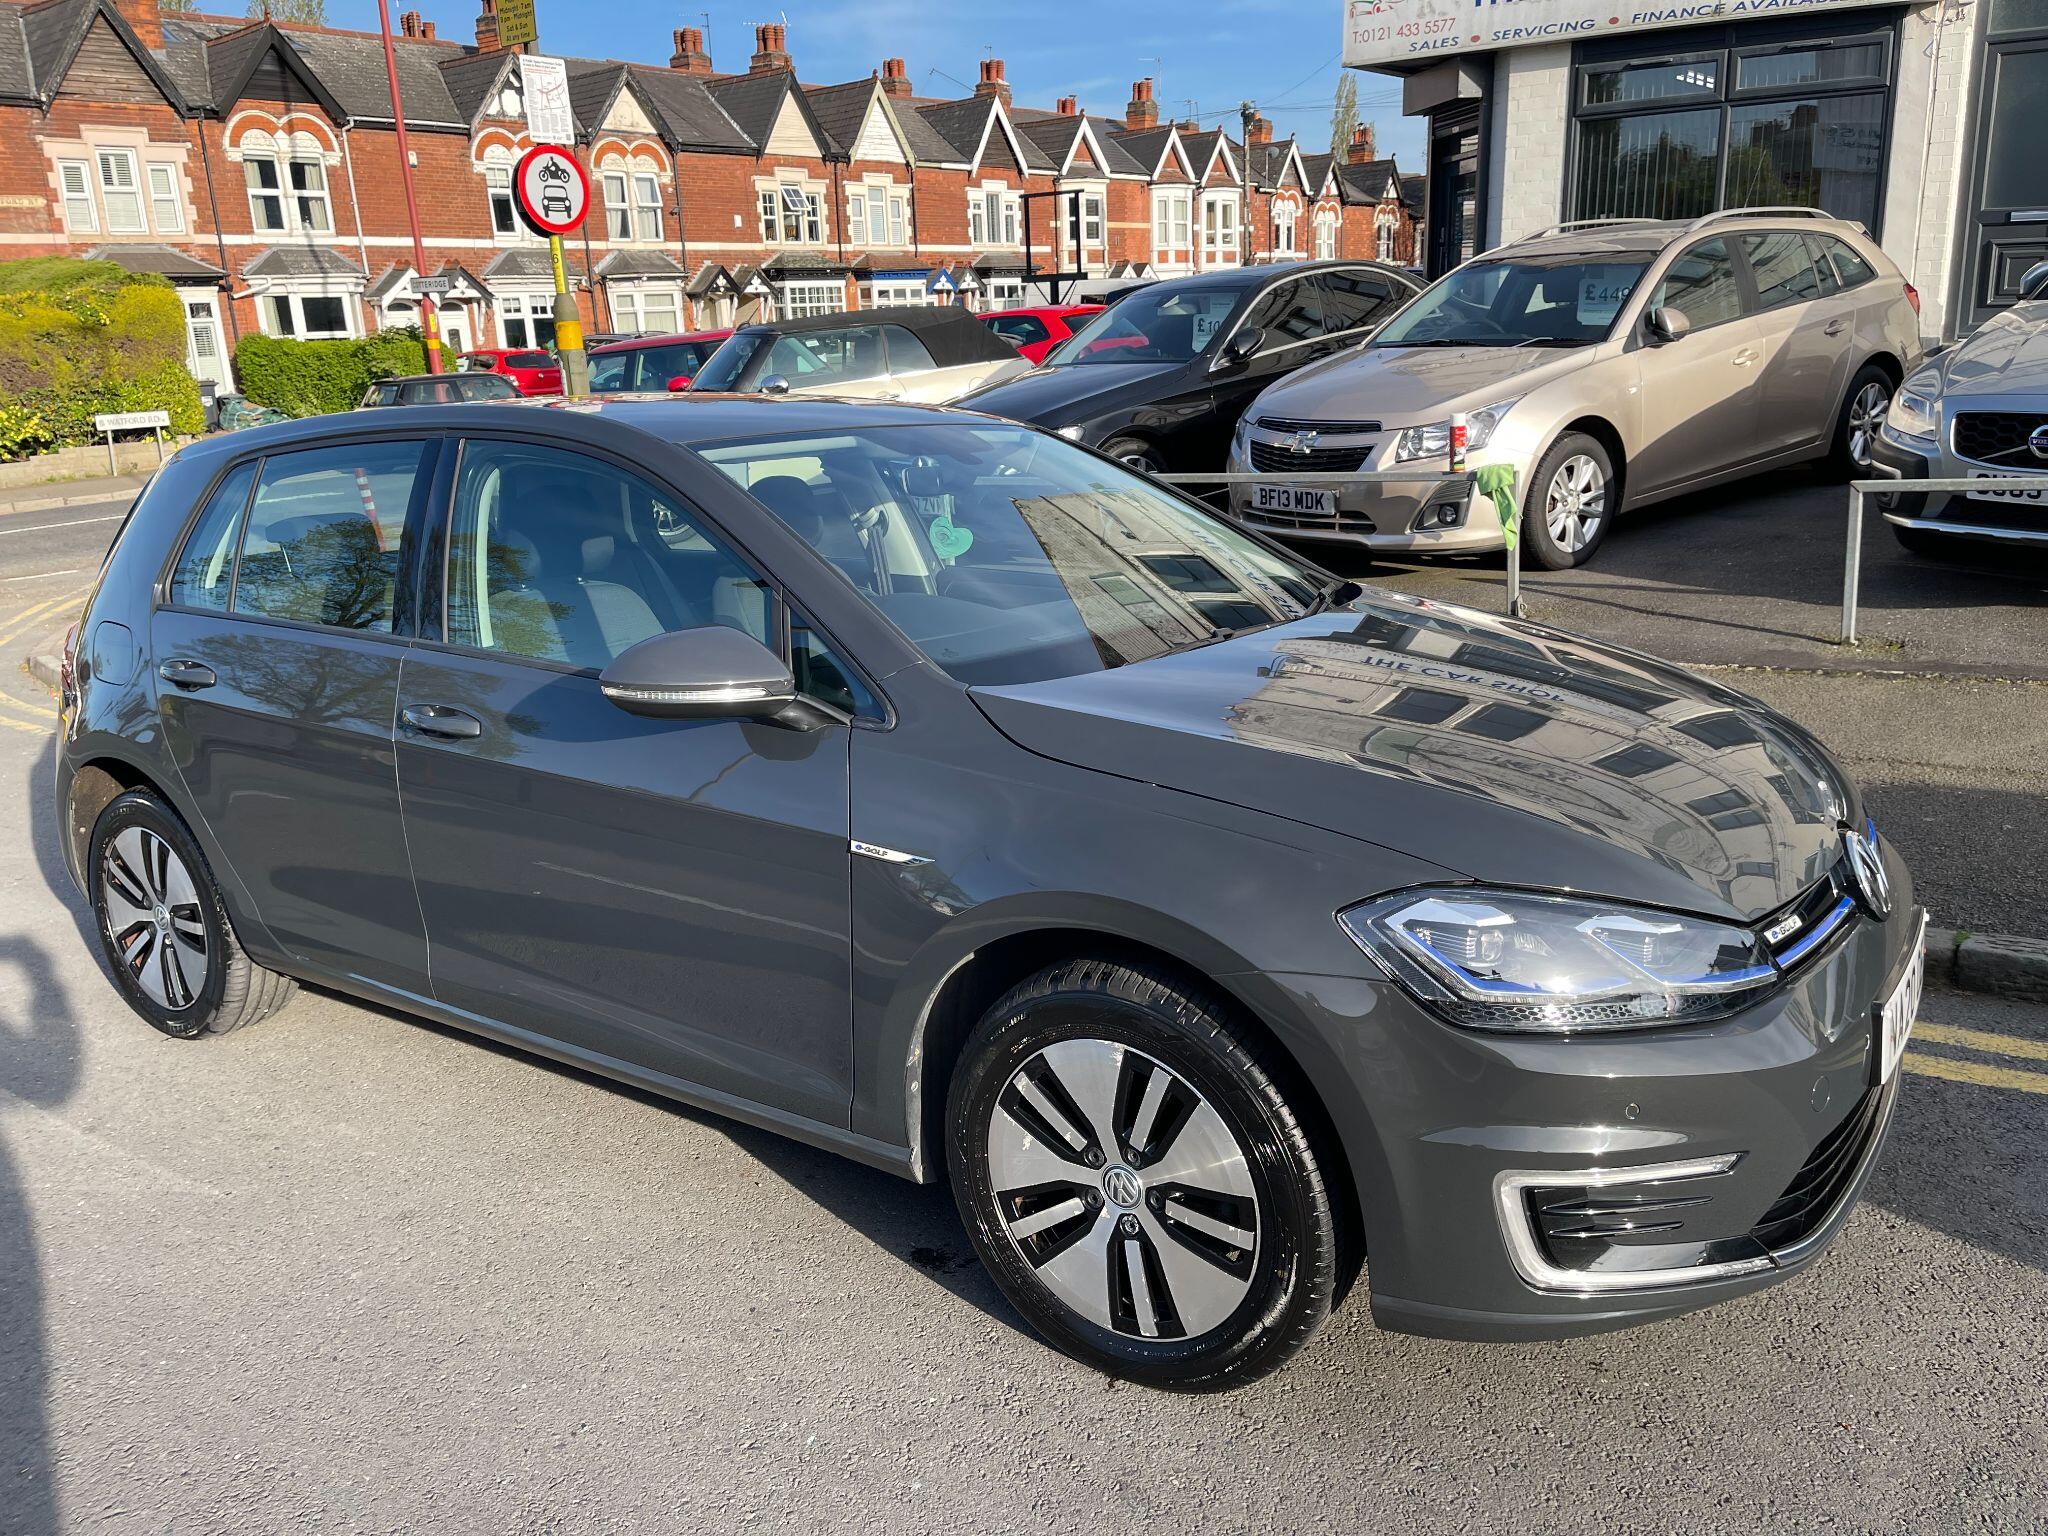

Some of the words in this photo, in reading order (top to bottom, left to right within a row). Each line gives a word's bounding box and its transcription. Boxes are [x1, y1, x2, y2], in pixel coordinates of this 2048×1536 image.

[1353, 27, 1391, 44] T:0121
[1397, 22, 1420, 38] 433
[1424, 17, 1456, 35] 5577
[1409, 36, 1459, 52] SALES
[1492, 19, 1596, 41] SERVICING
[1631, 3, 1726, 24] FINANCE
[1732, 0, 1846, 13] AVAIL
[411, 279, 448, 290] COTTERIDGE
[106, 416, 146, 426] WATFORD
[148, 415, 160, 424] RD
[1260, 487, 1291, 508] BF13
[1295, 490, 1325, 511] MDK
[855, 844, 889, 857] e-GOLF
[1771, 917, 1798, 940] e-GOLF
